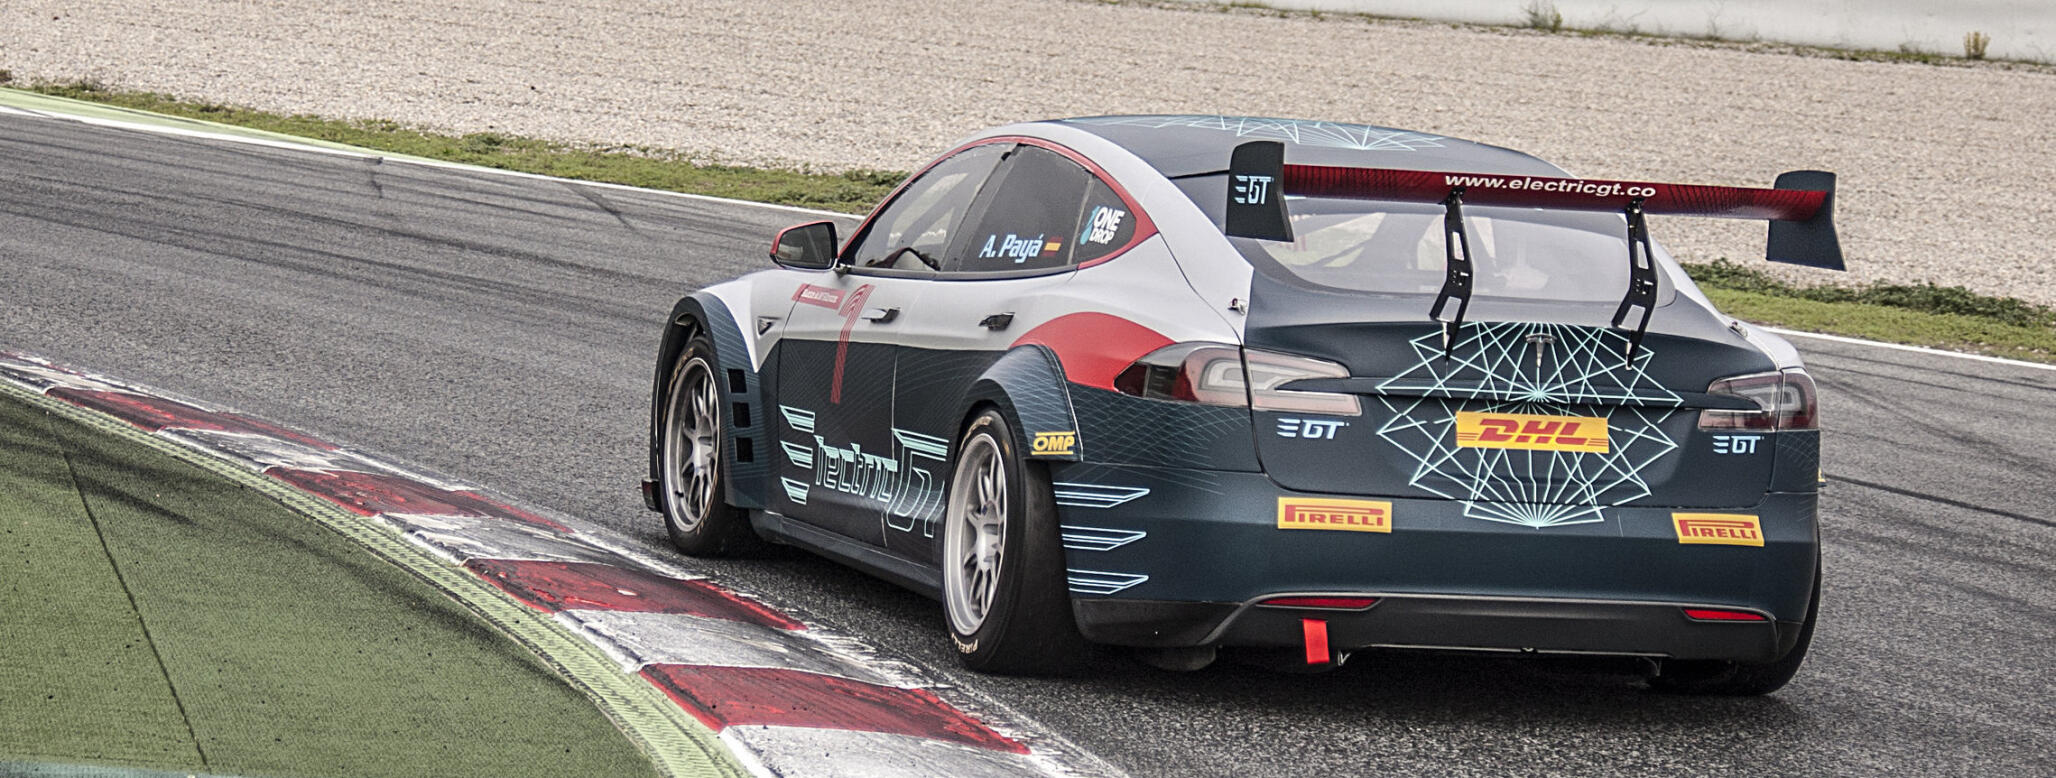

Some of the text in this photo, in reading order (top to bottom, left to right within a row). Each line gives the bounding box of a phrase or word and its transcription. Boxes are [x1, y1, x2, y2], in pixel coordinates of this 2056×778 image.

[1445, 175, 1657, 198] www.electricgt.co
[1093, 206, 1126, 231] ONE
[978, 233, 1045, 264] A. Payá
[1089, 228, 1115, 245] DROP
[1033, 435, 1076, 452] OMP
[1478, 418, 1588, 446] DHL
